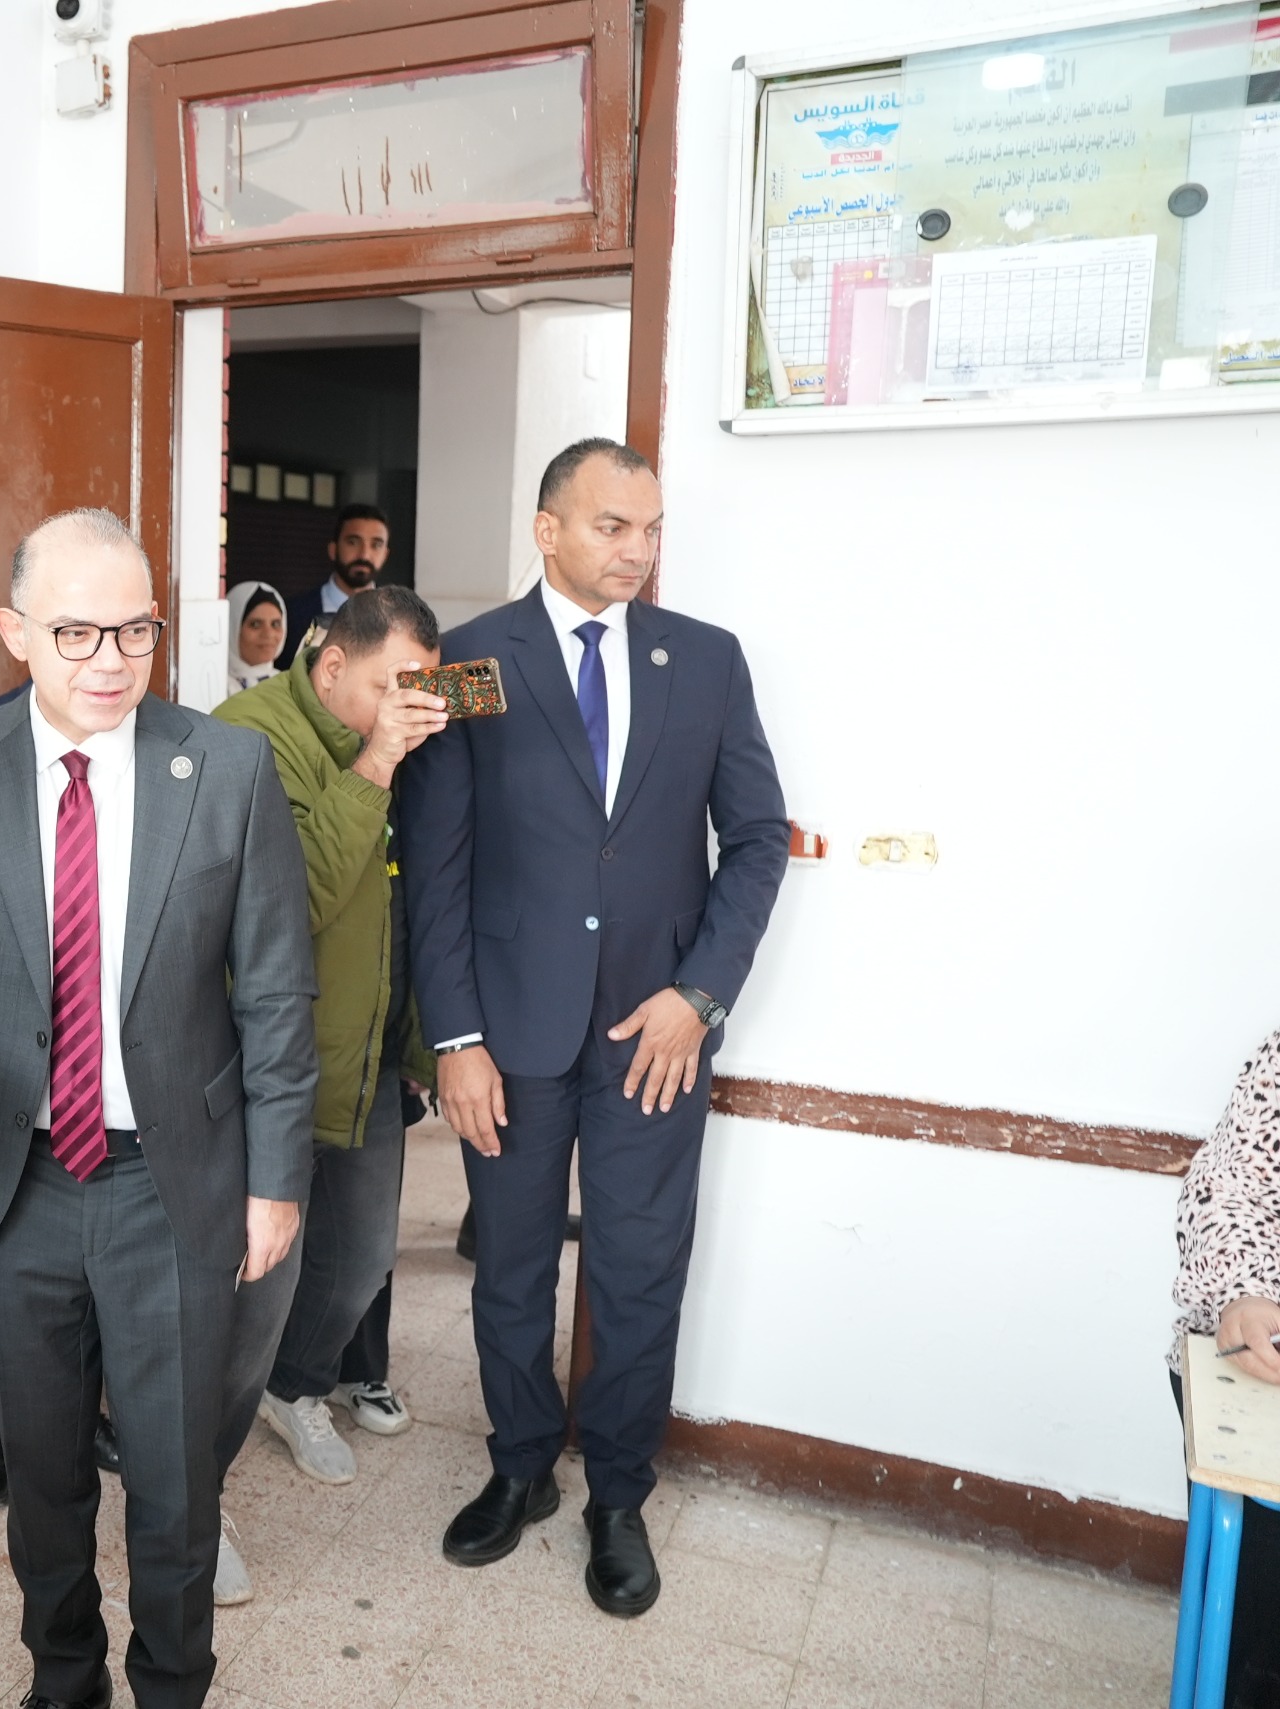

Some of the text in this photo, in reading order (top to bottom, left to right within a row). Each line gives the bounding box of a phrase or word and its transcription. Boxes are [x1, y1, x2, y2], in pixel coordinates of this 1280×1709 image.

[794, 95, 875, 122] السويس
[838, 150, 874, 163] الجديدة
[836, 194, 873, 216] الحصص
